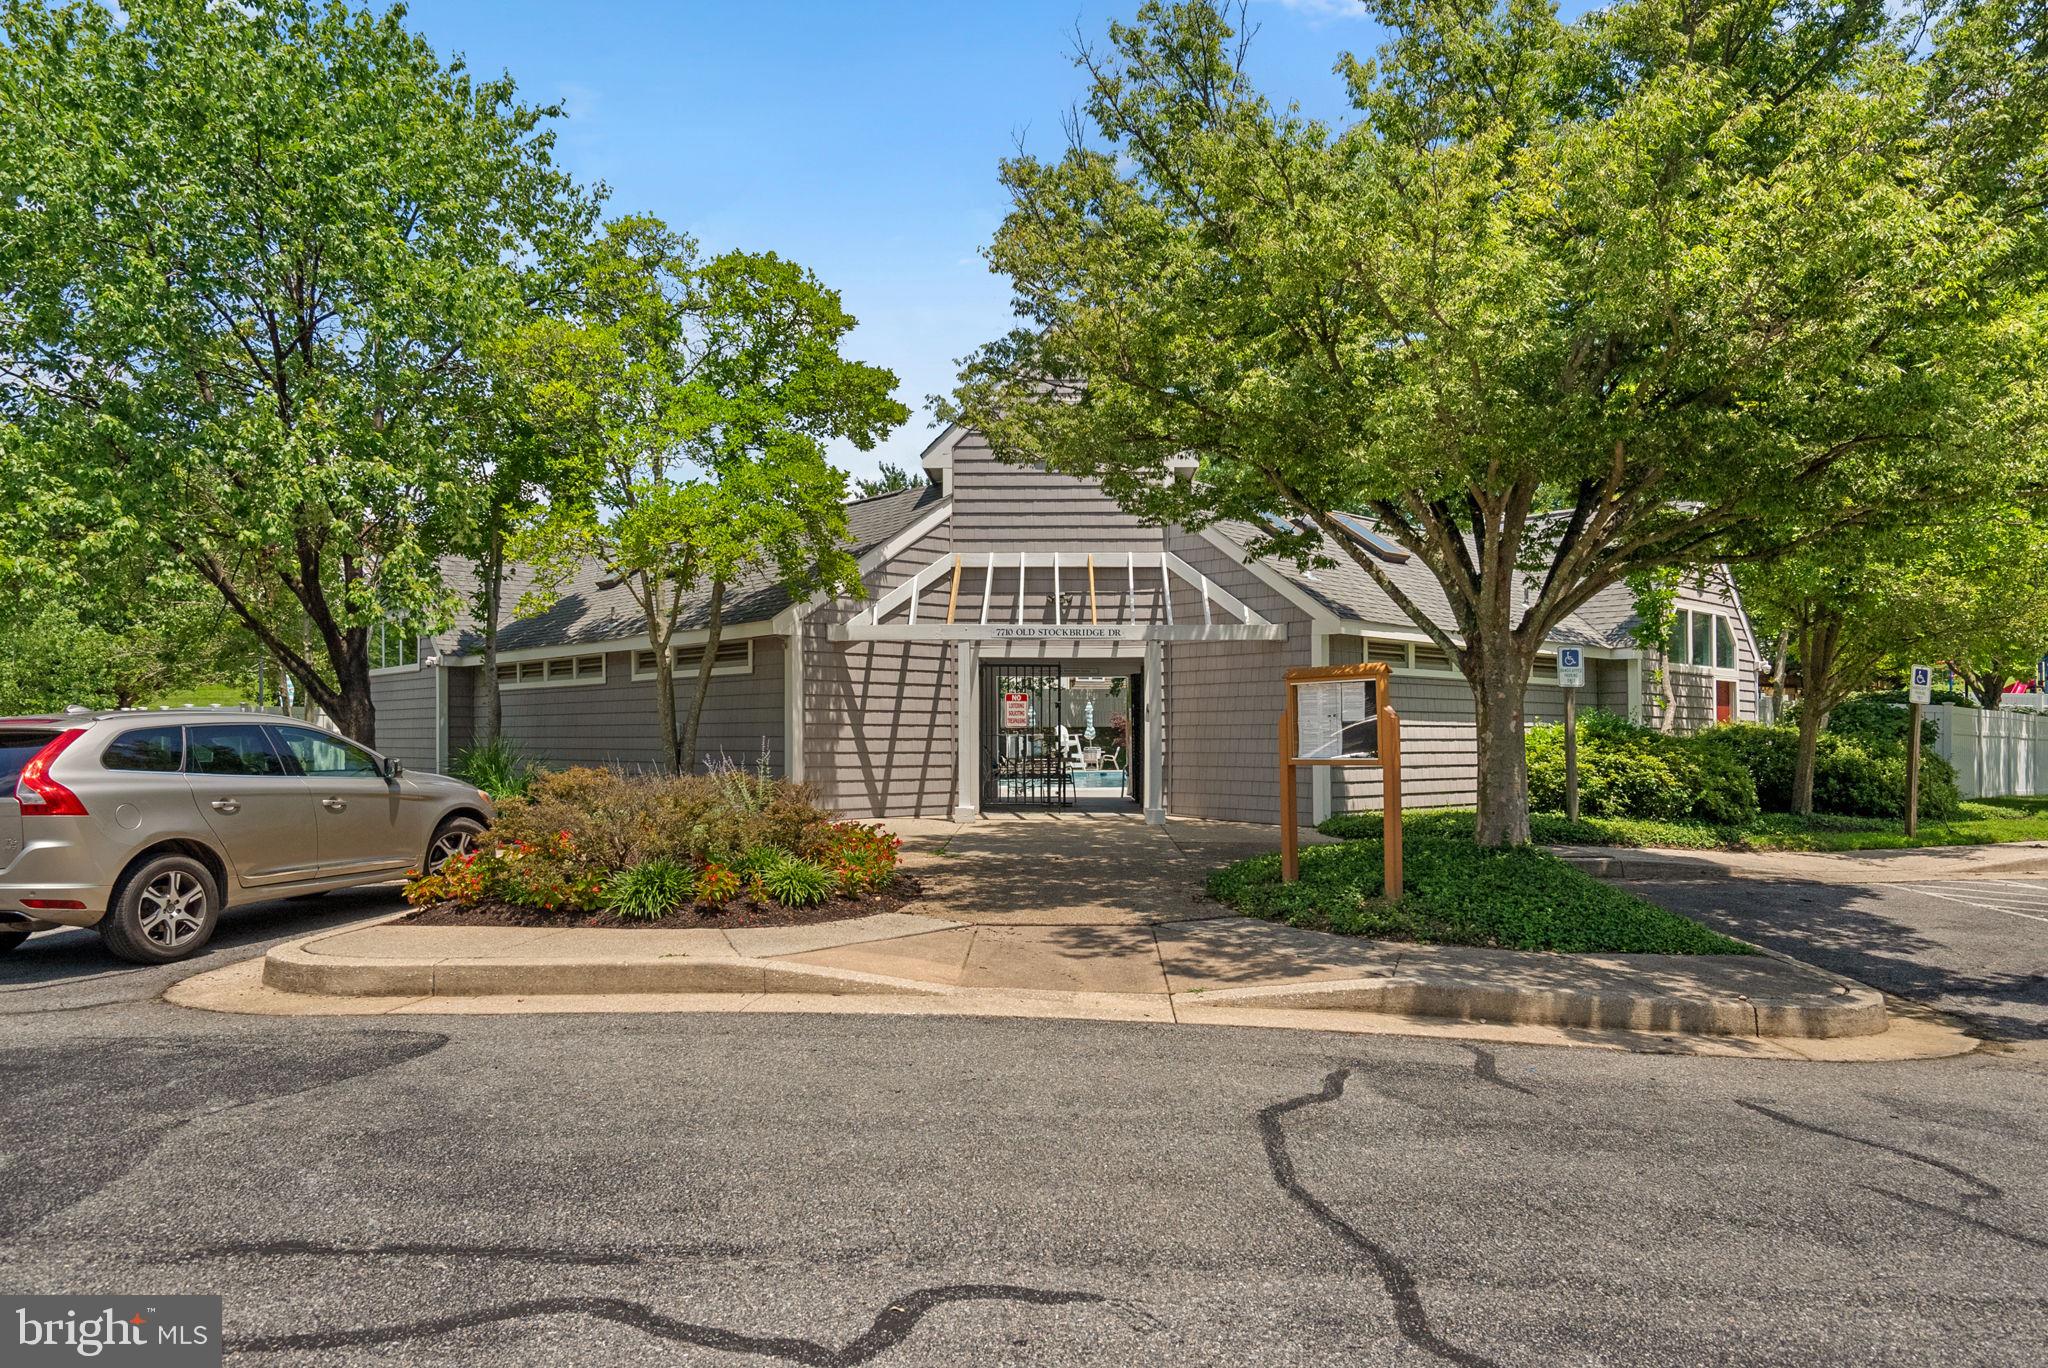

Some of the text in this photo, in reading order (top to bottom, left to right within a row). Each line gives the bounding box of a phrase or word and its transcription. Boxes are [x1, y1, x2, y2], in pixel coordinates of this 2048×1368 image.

[996, 628, 1121, 637] 7710 OLD STOCKBRIDGE DR
